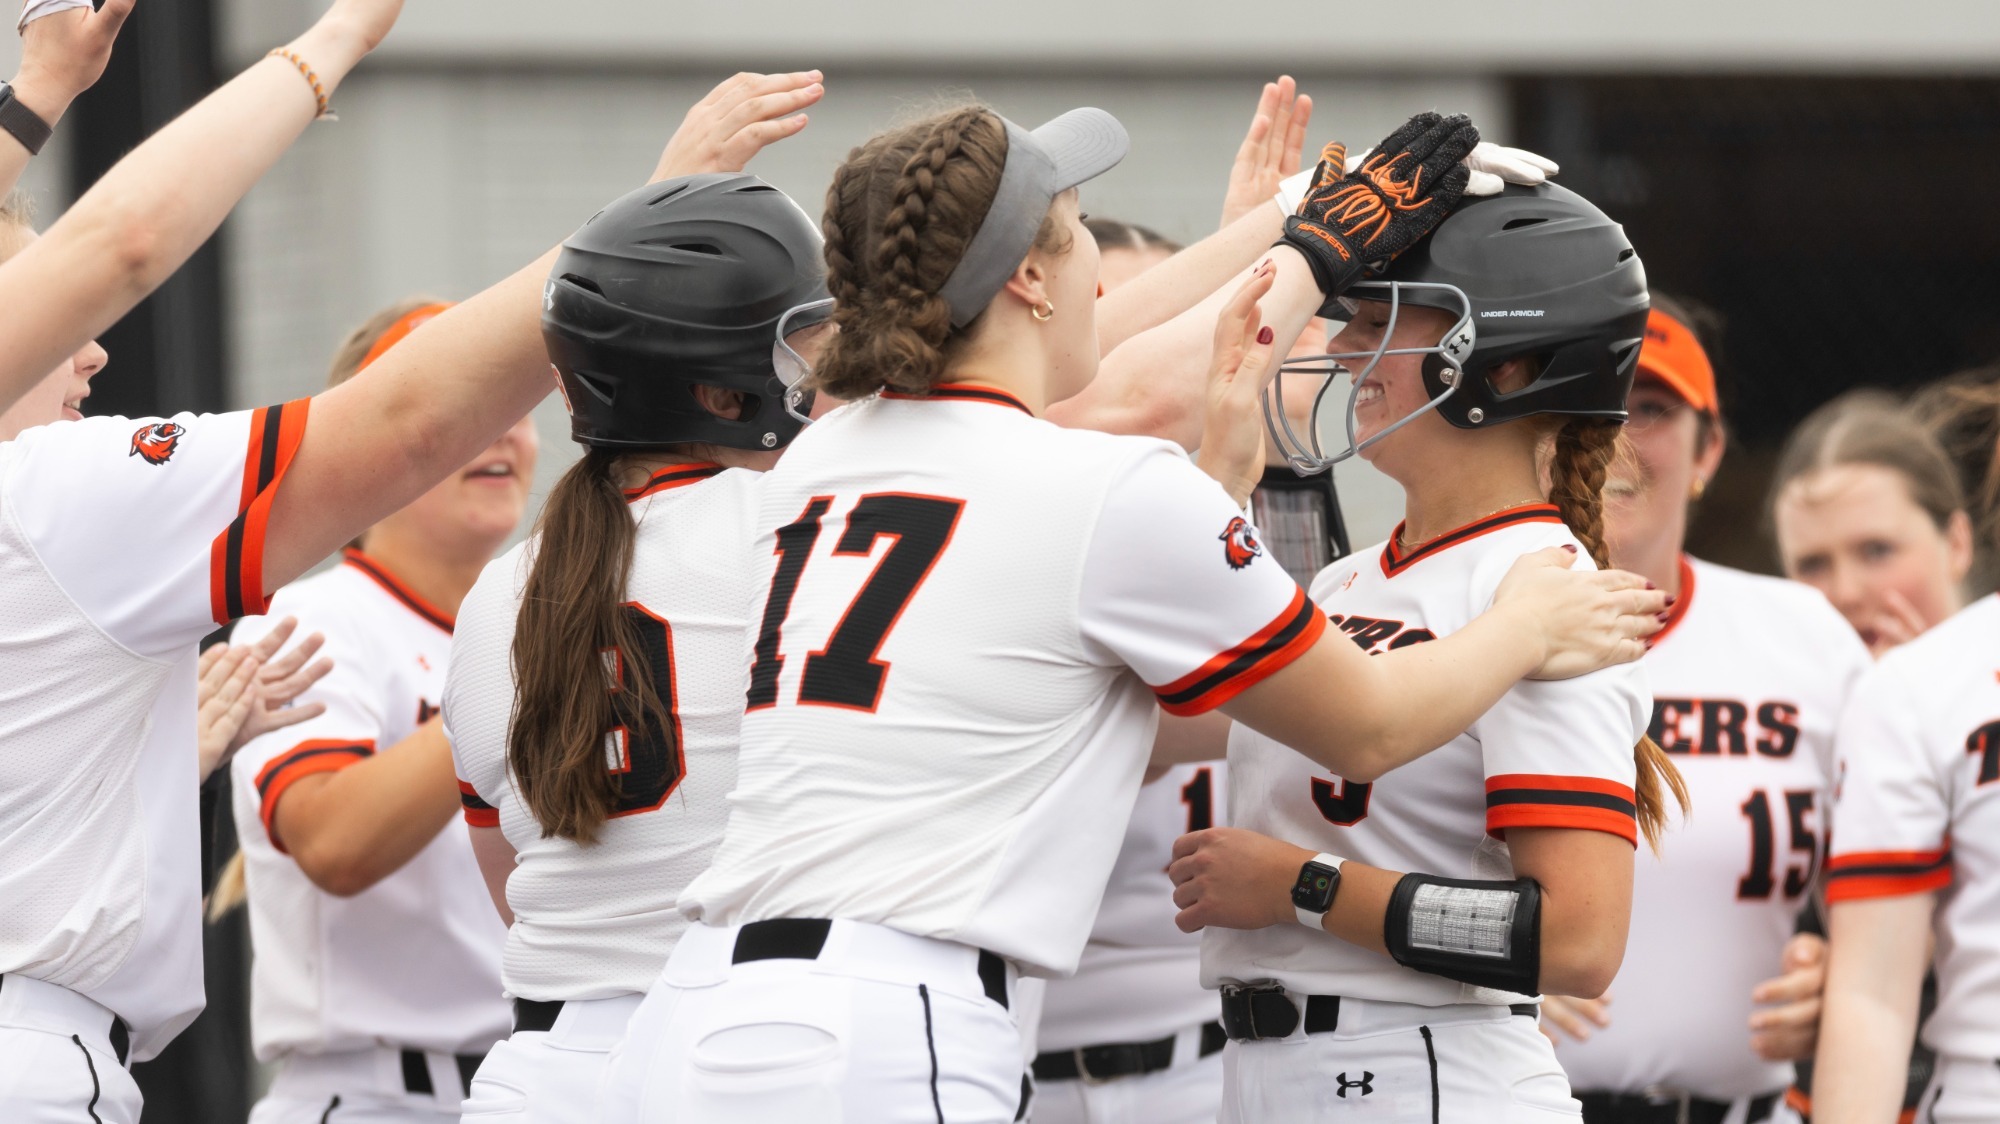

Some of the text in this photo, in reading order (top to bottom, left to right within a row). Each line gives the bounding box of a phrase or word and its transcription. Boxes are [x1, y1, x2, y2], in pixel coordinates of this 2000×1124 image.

[1297, 223, 1351, 262] SPIDERZ
[1480, 309, 1545, 318] UNDER ARMOUR
[744, 490, 968, 715] 17
[1646, 696, 1802, 758] ERS
[1736, 786, 1819, 901] 15
